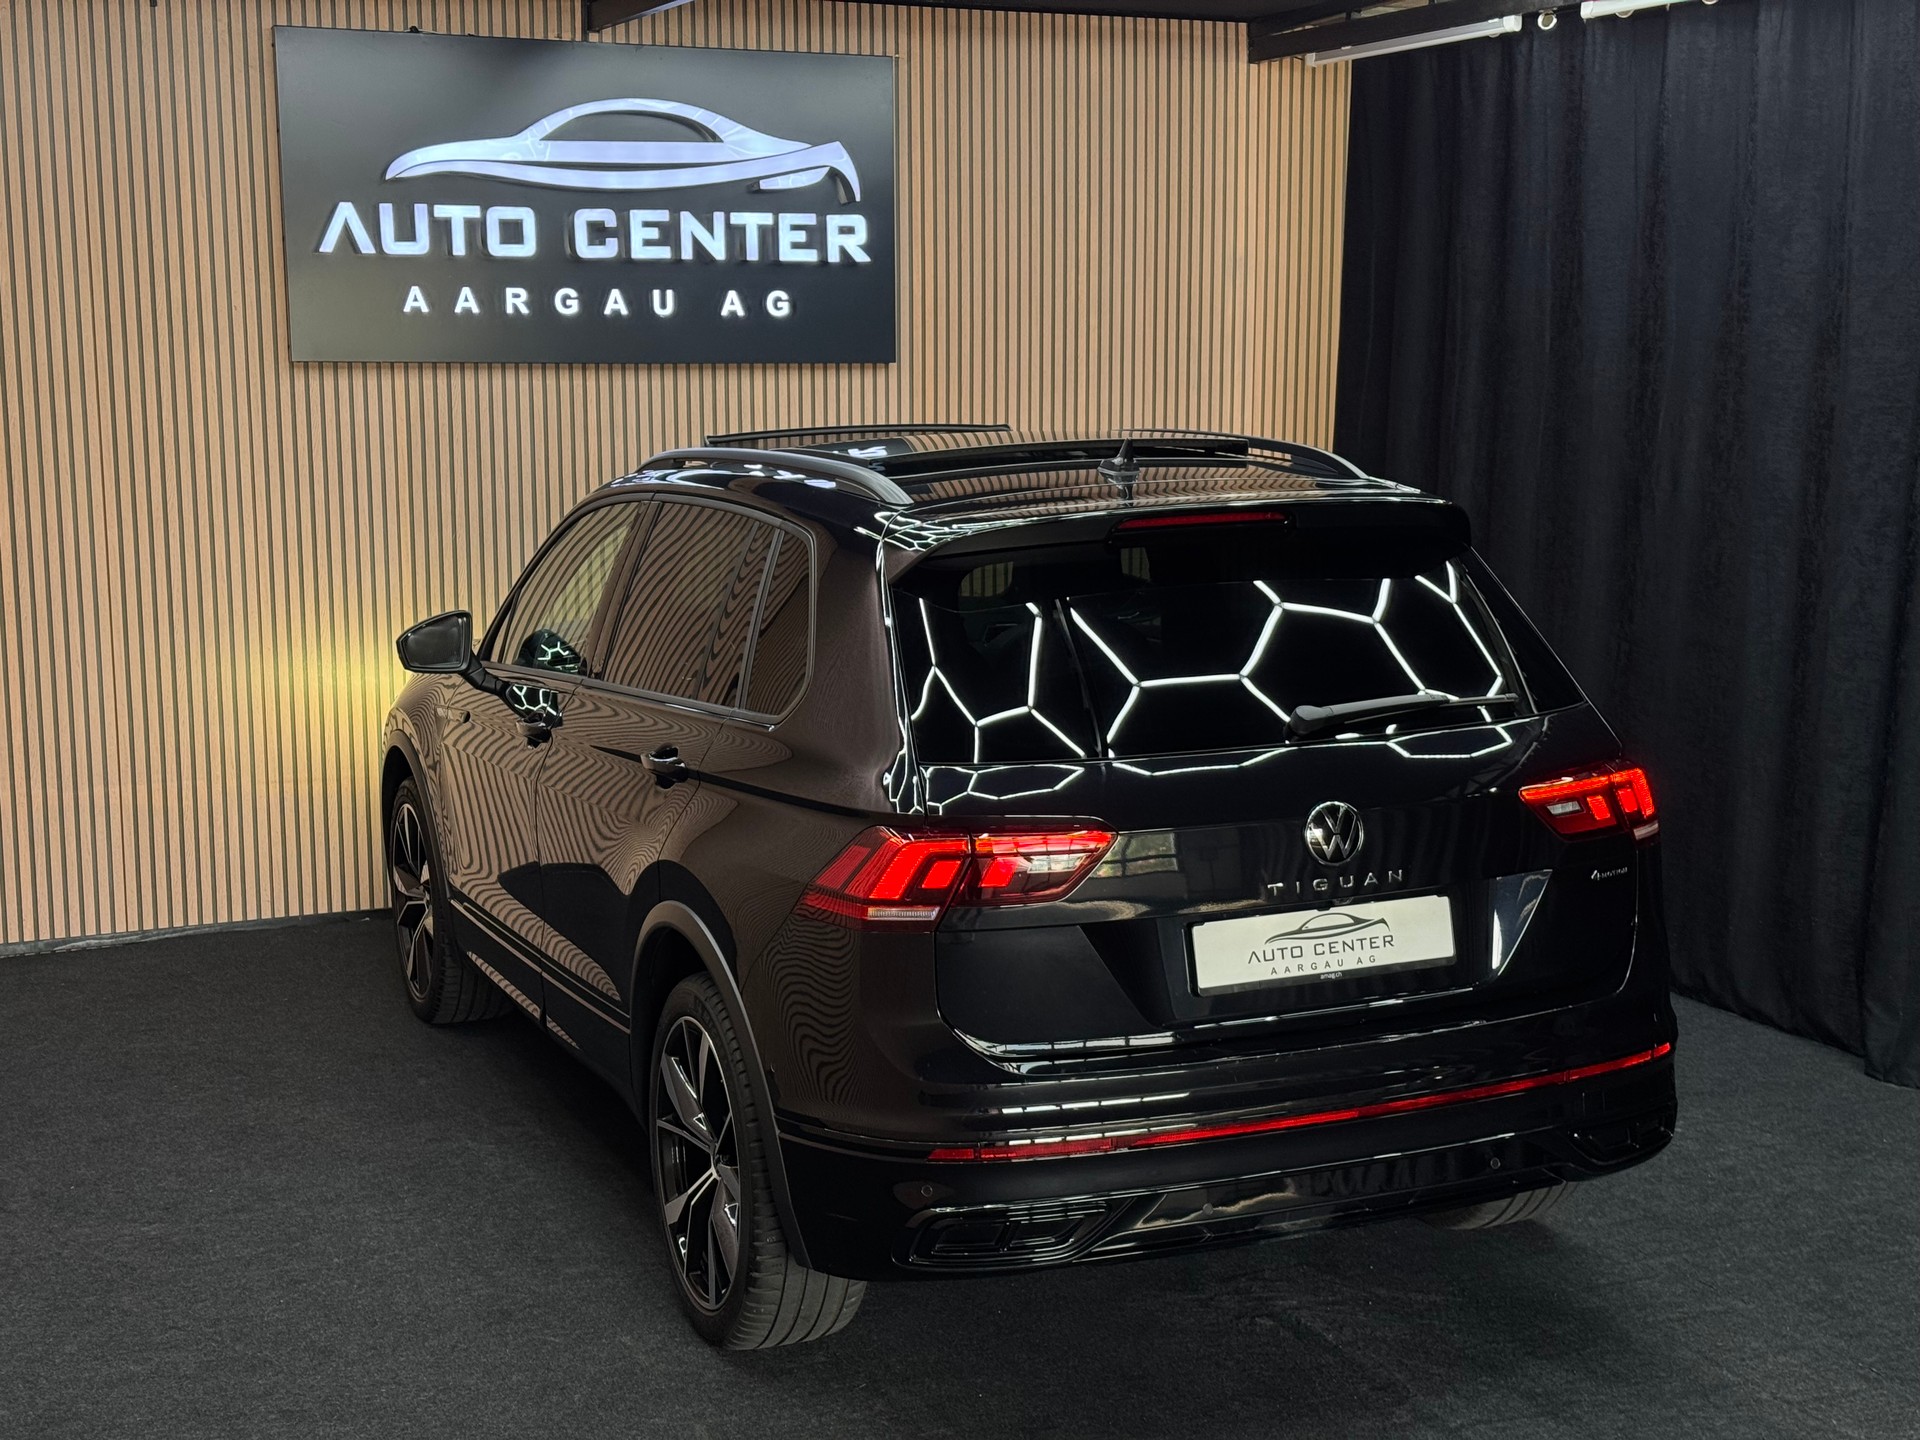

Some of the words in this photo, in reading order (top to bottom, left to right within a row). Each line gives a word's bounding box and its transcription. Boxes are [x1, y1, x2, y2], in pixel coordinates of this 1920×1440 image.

[318, 201, 537, 257] AUTO
[571, 207, 871, 263] CENTER
[403, 286, 675, 316] AARGAU
[720, 290, 792, 318] AG
[1267, 869, 1403, 896] TIGUAN
[1247, 945, 1304, 964] AUTO
[1313, 934, 1395, 956] CENTER
[1270, 958, 1344, 976] AARGAU
[1356, 954, 1376, 966] AG
